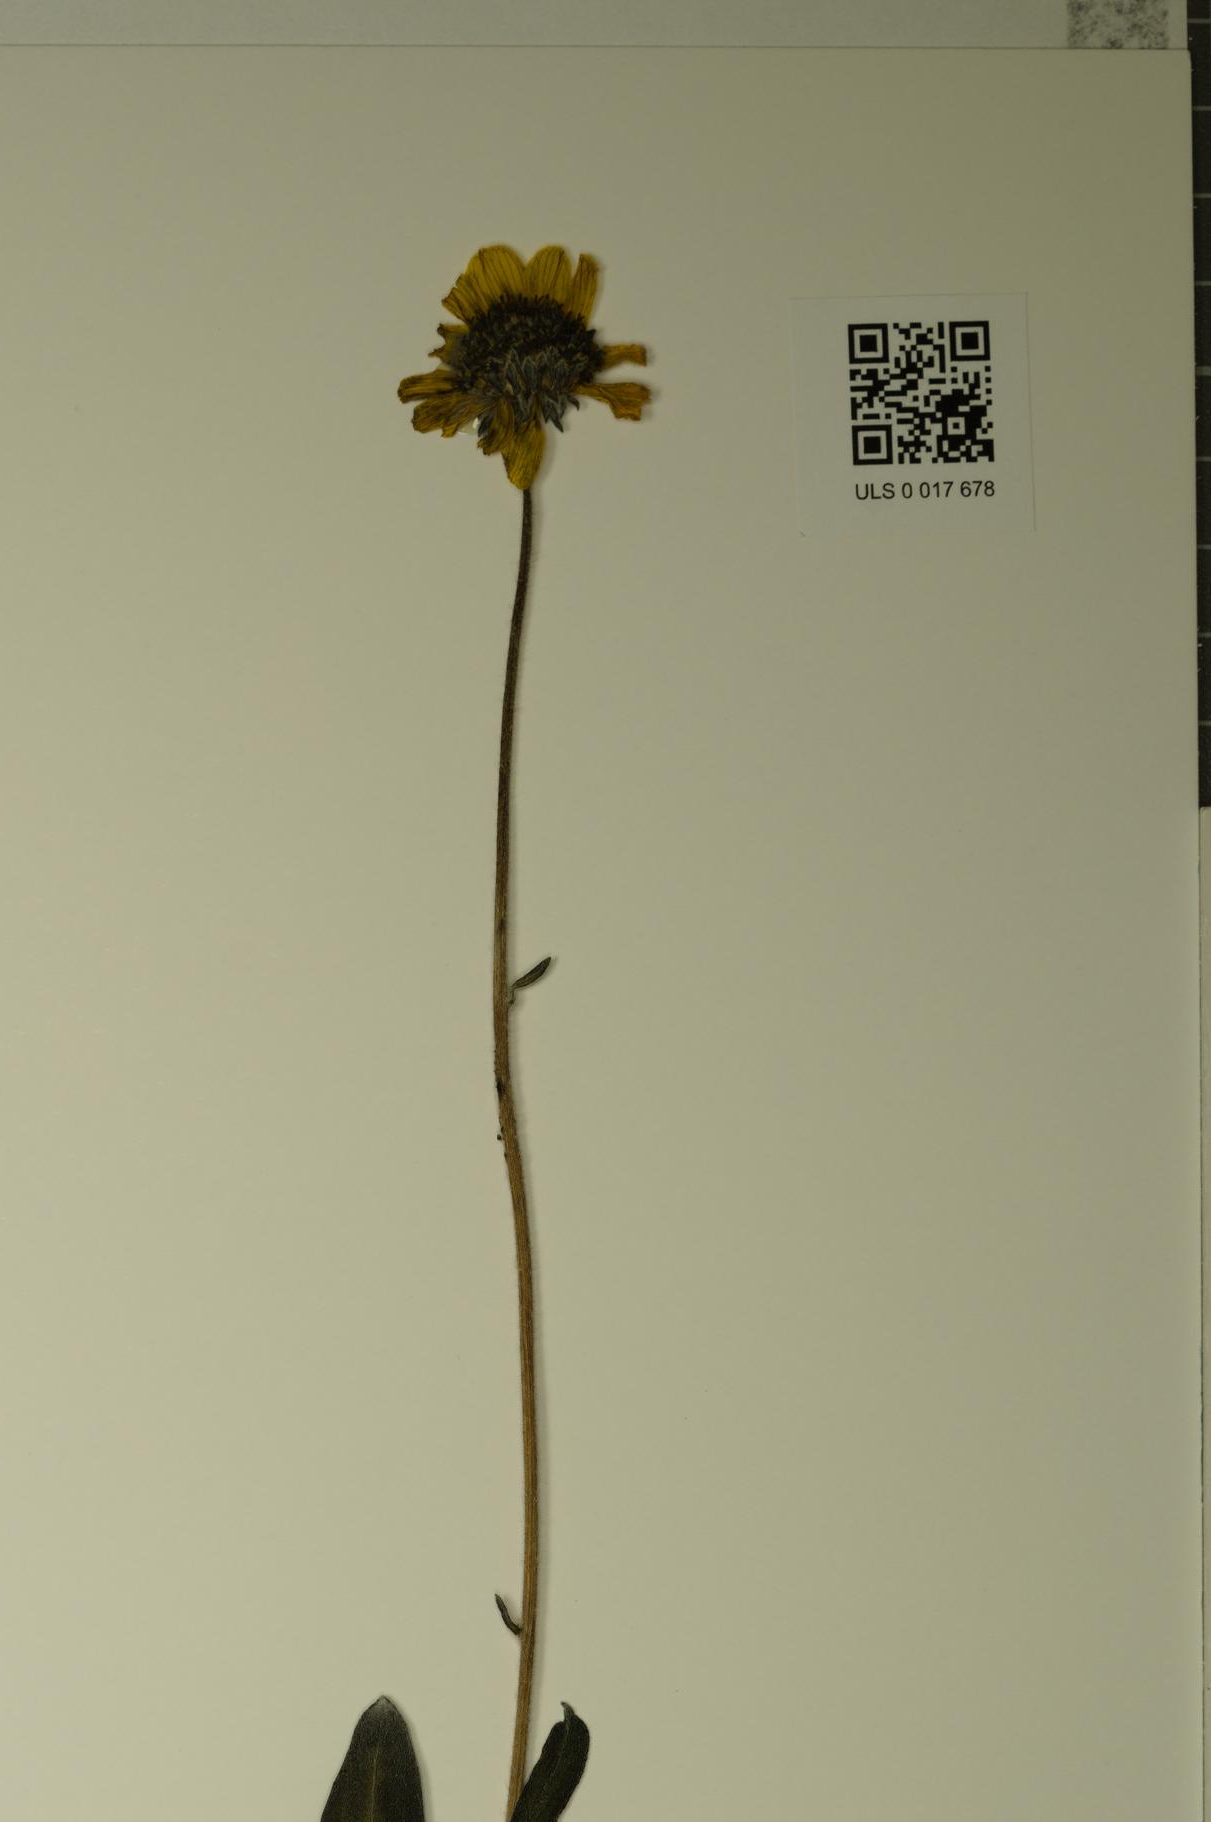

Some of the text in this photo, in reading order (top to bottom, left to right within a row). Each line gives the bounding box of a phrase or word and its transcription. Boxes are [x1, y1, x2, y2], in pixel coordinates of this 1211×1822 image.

[855, 480, 996, 501] ULS 0 017 678
